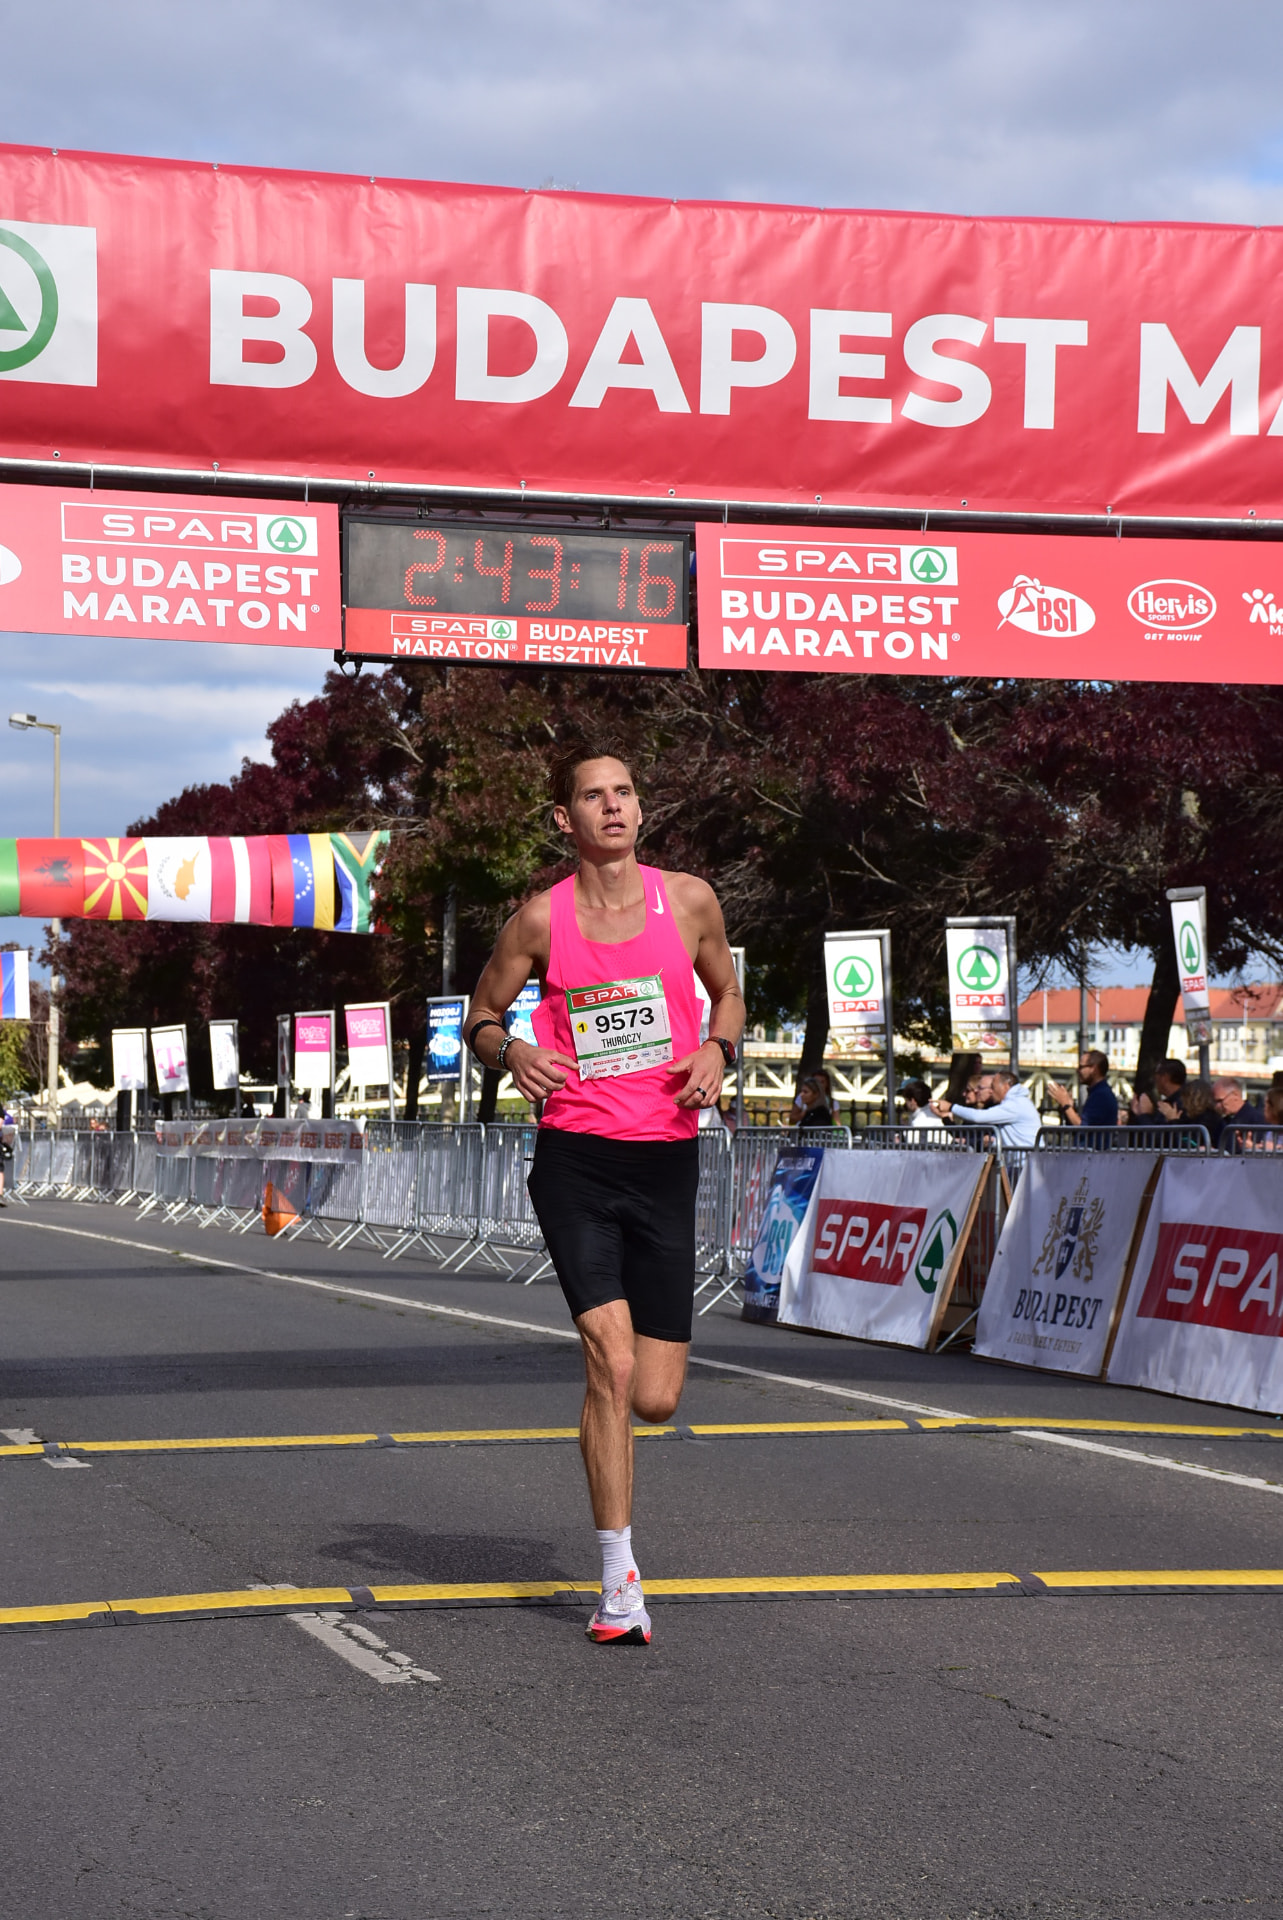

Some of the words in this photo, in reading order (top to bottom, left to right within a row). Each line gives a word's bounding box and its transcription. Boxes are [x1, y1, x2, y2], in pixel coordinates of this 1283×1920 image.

[210, 269, 1088, 429] BUDAPEST
[1137, 322, 1283, 436] M
[102, 514, 252, 544] SPAR
[61, 553, 319, 597] BUDAPEST
[758, 549, 897, 576] SPAR
[720, 589, 960, 626] BUDAPEST
[1036, 598, 1078, 632] BSI
[1137, 591, 1209, 619] Hervis
[1147, 614, 1176, 622] SPORTS
[411, 620, 486, 635] SPAR
[529, 623, 649, 645] BUDAPEST
[1269, 624, 1283, 636] M
[524, 644, 646, 666] FESZTIVÁL
[584, 986, 637, 1004] SPAR
[1183, 977, 1205, 992] SPAR
[833, 1001, 879, 1012] SPAR
[956, 995, 1005, 1006] SPAR
[578, 1023, 585, 1033] 1
[595, 1007, 655, 1034] 9573
[601, 1032, 642, 1049] THURÓCZY
[814, 1213, 919, 1273] SPAR
[1166, 1243, 1283, 1317] SPA
[1012, 1288, 1103, 1330] BUDAPEST
